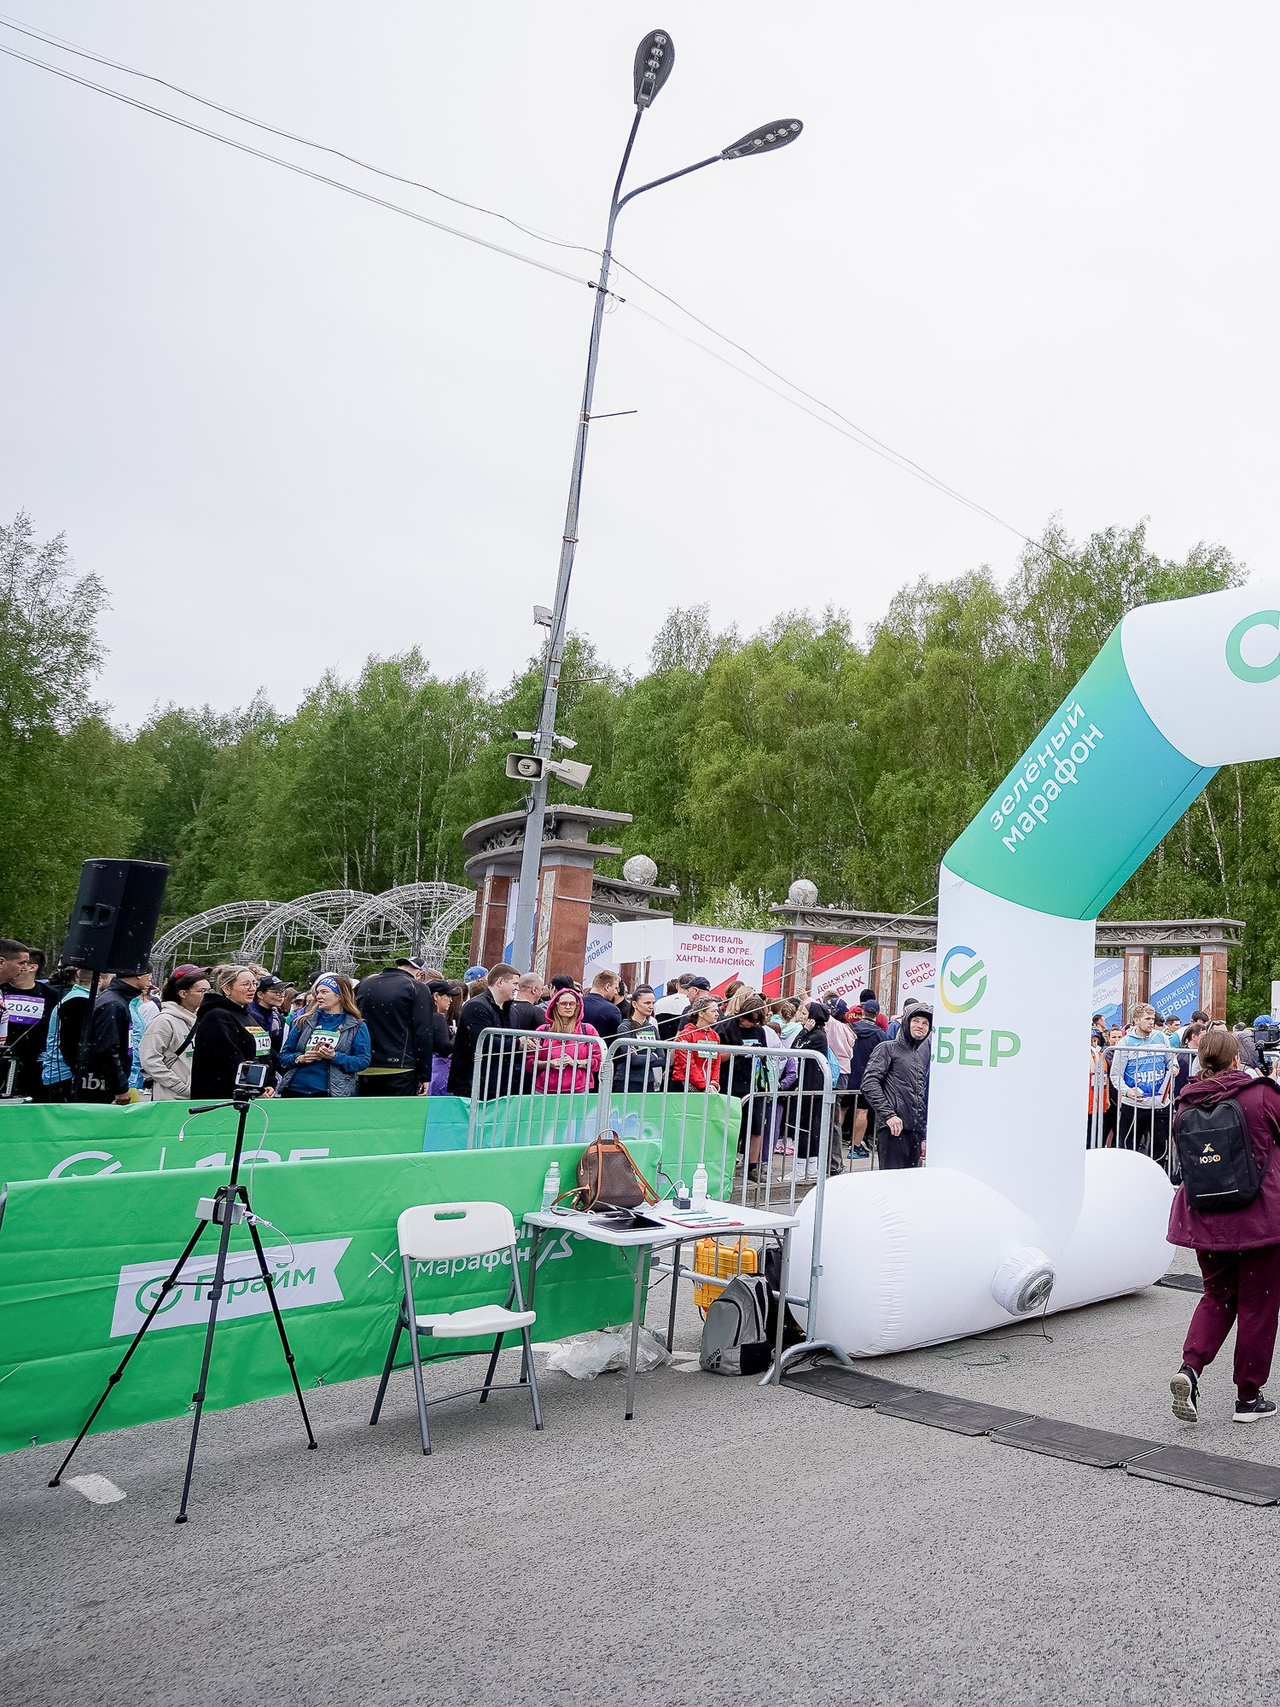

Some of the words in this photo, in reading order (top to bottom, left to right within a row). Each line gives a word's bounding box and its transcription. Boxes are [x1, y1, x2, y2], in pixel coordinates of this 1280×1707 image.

[989, 700, 1086, 831] зелёный
[1001, 722, 1105, 853] марафон
[587, 940, 600, 951] ЫТЬ
[680, 942, 715, 953] ПЕРВЫХ
[718, 943, 724, 953] В
[692, 933, 744, 945] ФЕСТИВАЛЬ
[675, 954, 755, 967] ХАНТЫ-МАНСИЙСК
[905, 962, 931, 978] БЫТЬ
[911, 968, 936, 987] РОСС
[1154, 962, 1190, 987] ФЕСТИВАЛЬ
[1156, 978, 1197, 1009] ДВИЖЕНИЕ
[8, 1003, 39, 1014] 2049
[1161, 990, 1198, 1020] ЕРВЫХ
